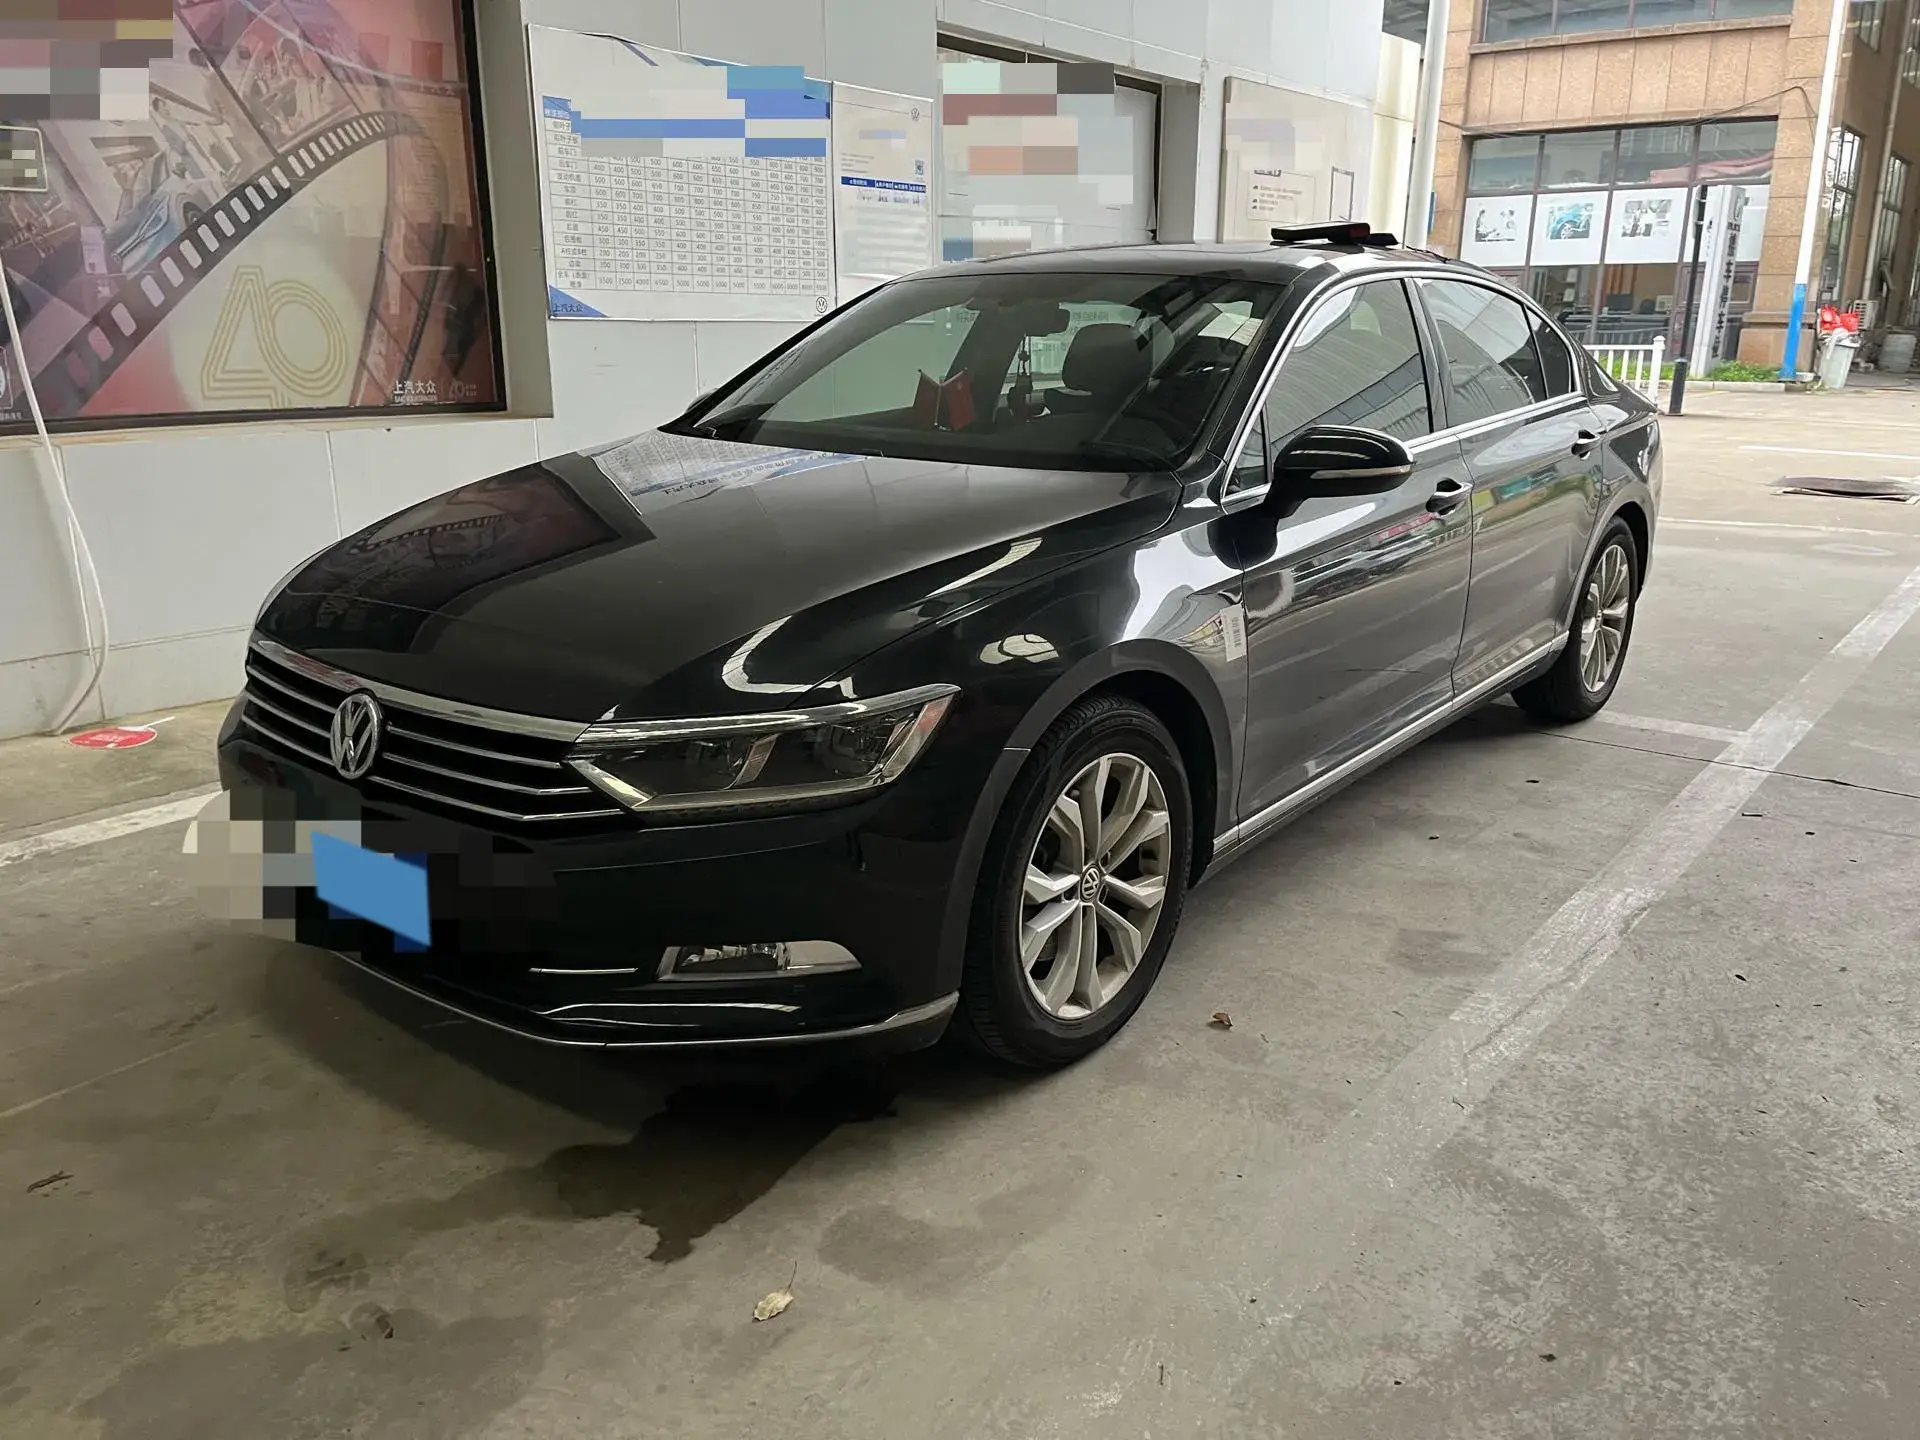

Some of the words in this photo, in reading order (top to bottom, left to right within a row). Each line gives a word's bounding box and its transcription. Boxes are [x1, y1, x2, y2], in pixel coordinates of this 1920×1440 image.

[553, 303, 583, 313] 上汽大众
[202, 264, 348, 412] 40
[393, 379, 437, 394] 上汽大众
